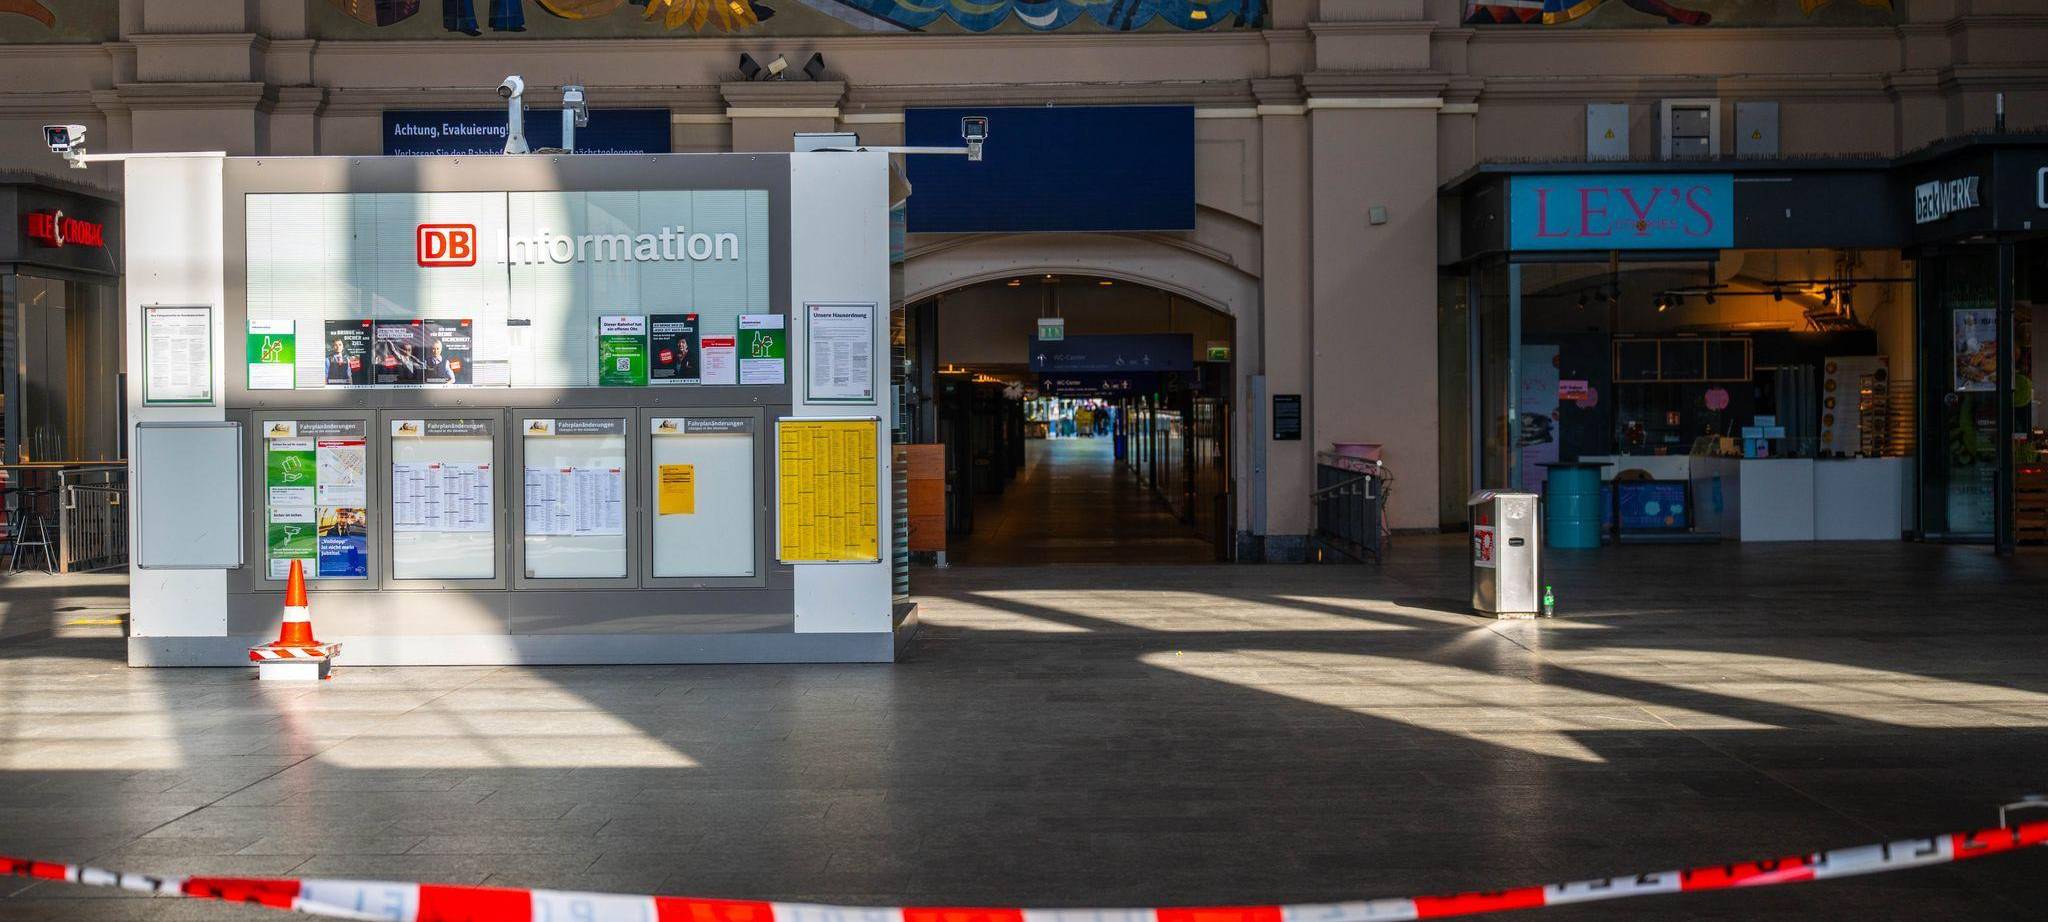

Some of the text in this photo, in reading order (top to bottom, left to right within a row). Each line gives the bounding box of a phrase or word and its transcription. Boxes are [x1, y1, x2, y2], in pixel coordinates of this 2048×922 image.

[395, 123, 509, 138] Achtung, Evakuierung!
[425, 225, 738, 263] DB Information
